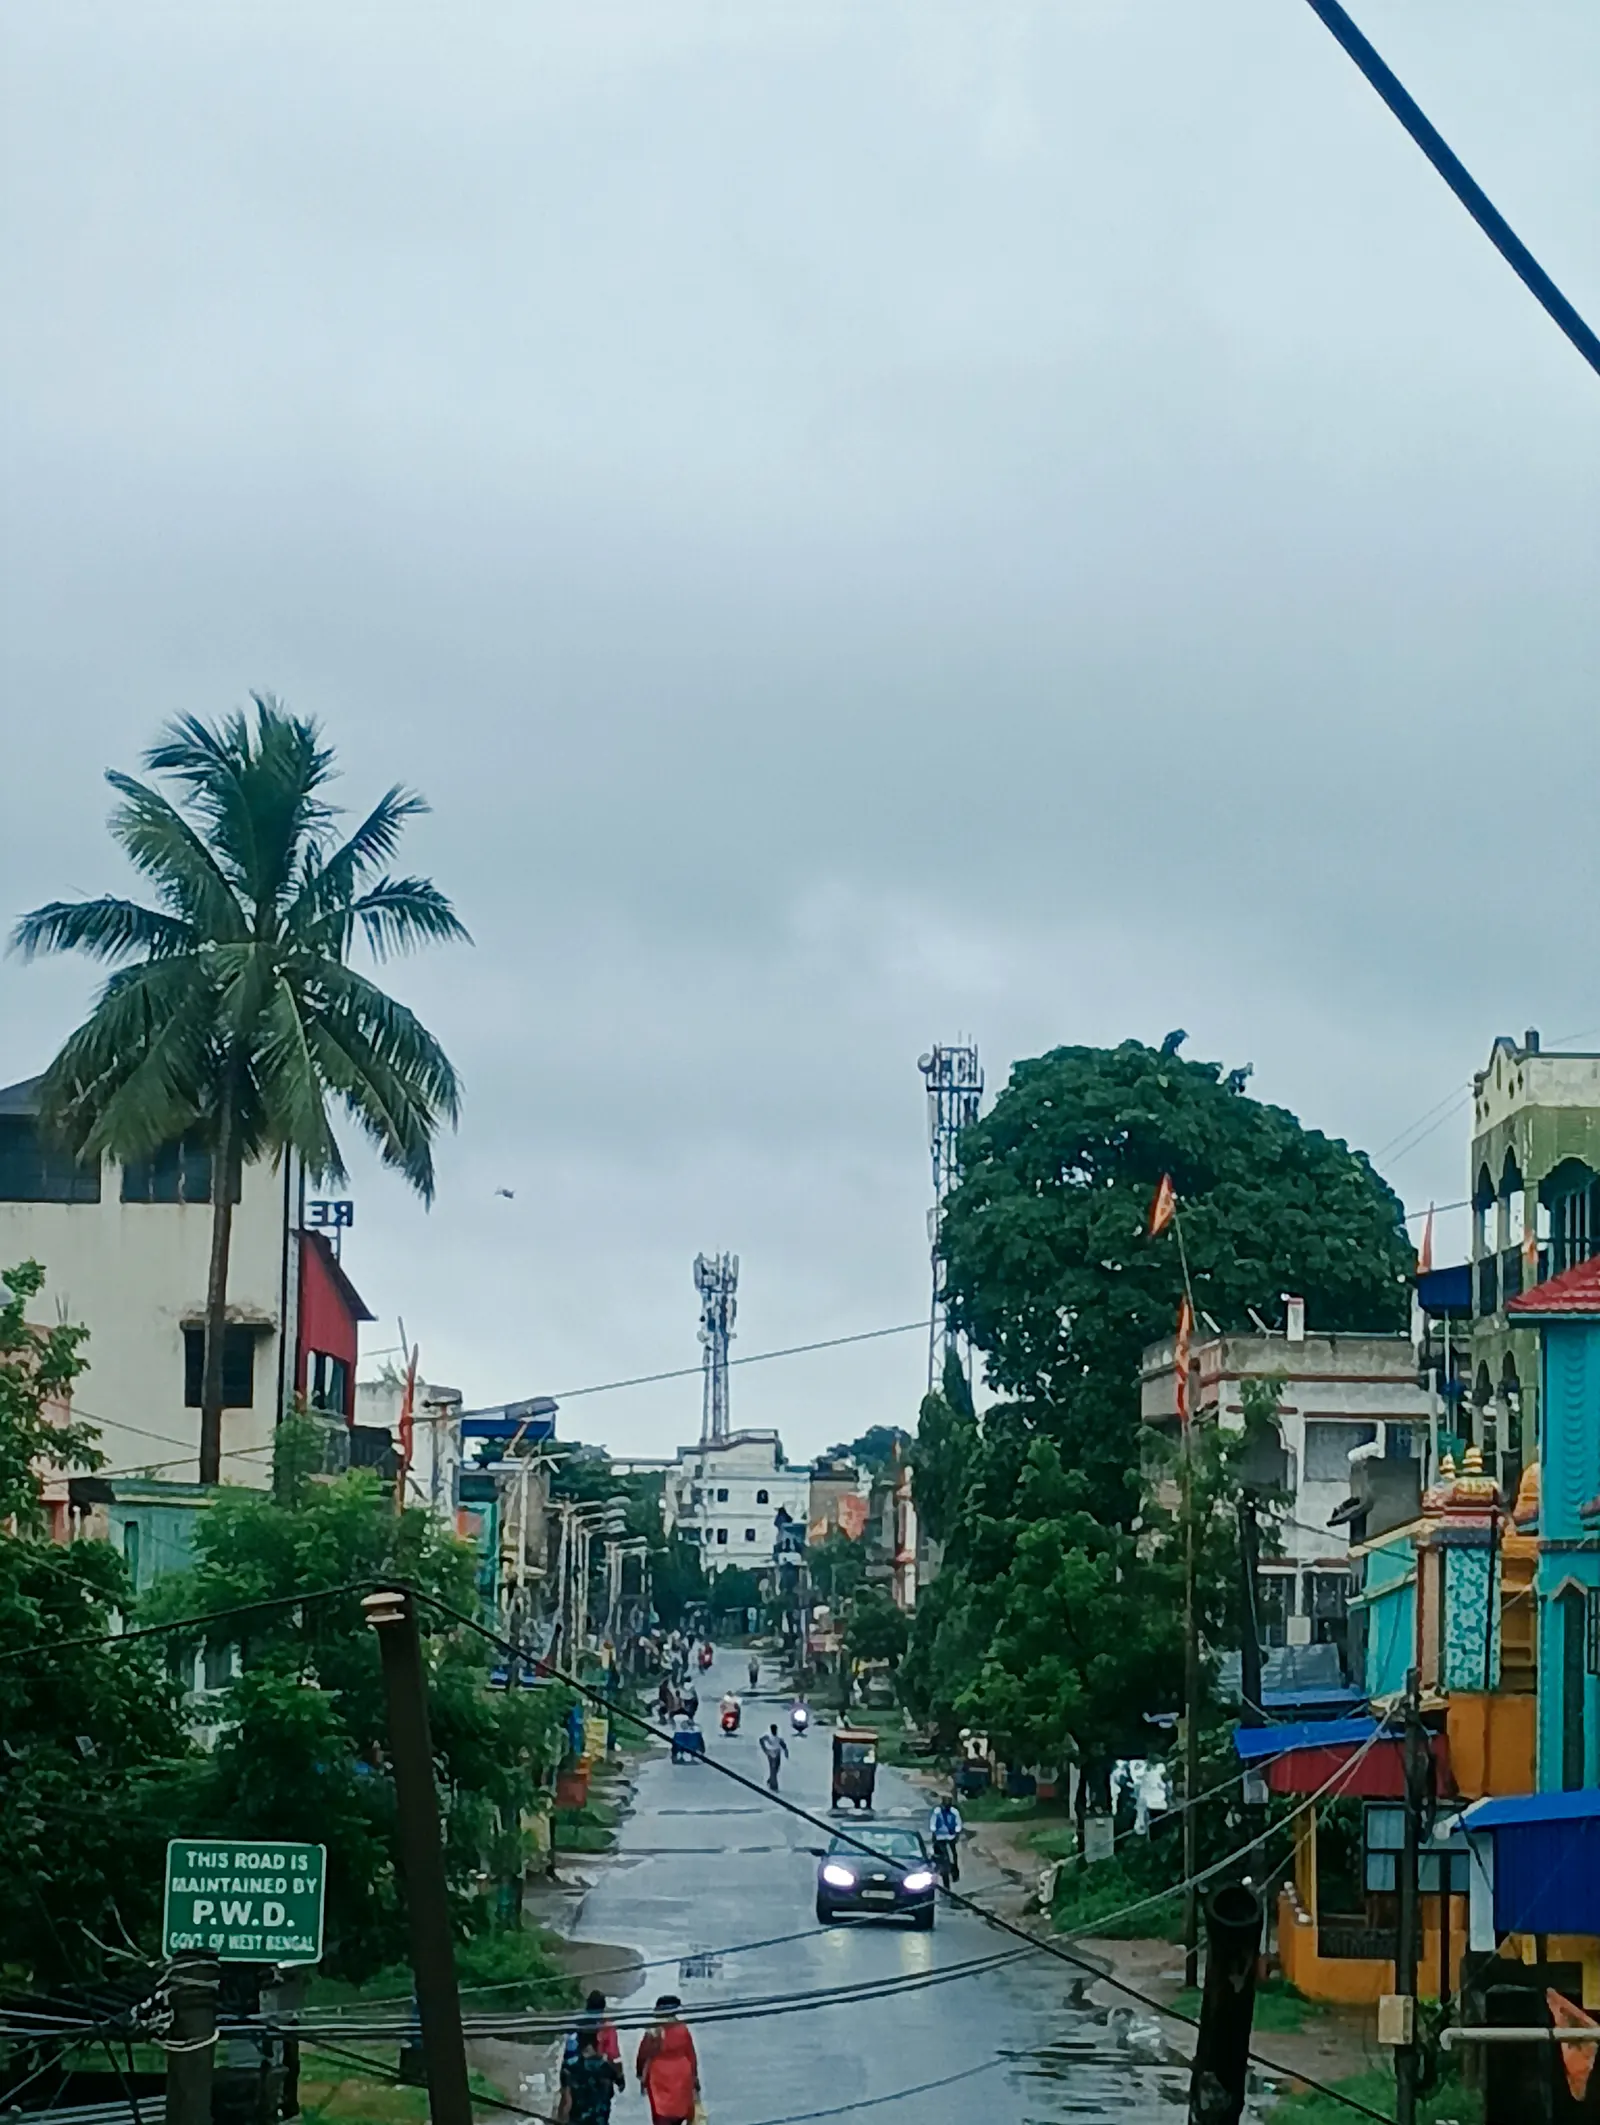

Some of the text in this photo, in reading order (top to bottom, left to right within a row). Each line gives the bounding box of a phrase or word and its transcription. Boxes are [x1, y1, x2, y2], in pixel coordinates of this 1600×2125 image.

[186, 1851, 308, 1870] THIS ROAD IS
[172, 1877, 317, 1894] MAINTAINED BY
[192, 1900, 295, 1927] P.W.D.
[209, 1933, 225, 1951] OF
[229, 1934, 262, 1950] WEST
[266, 1935, 315, 1951] BENGAL
